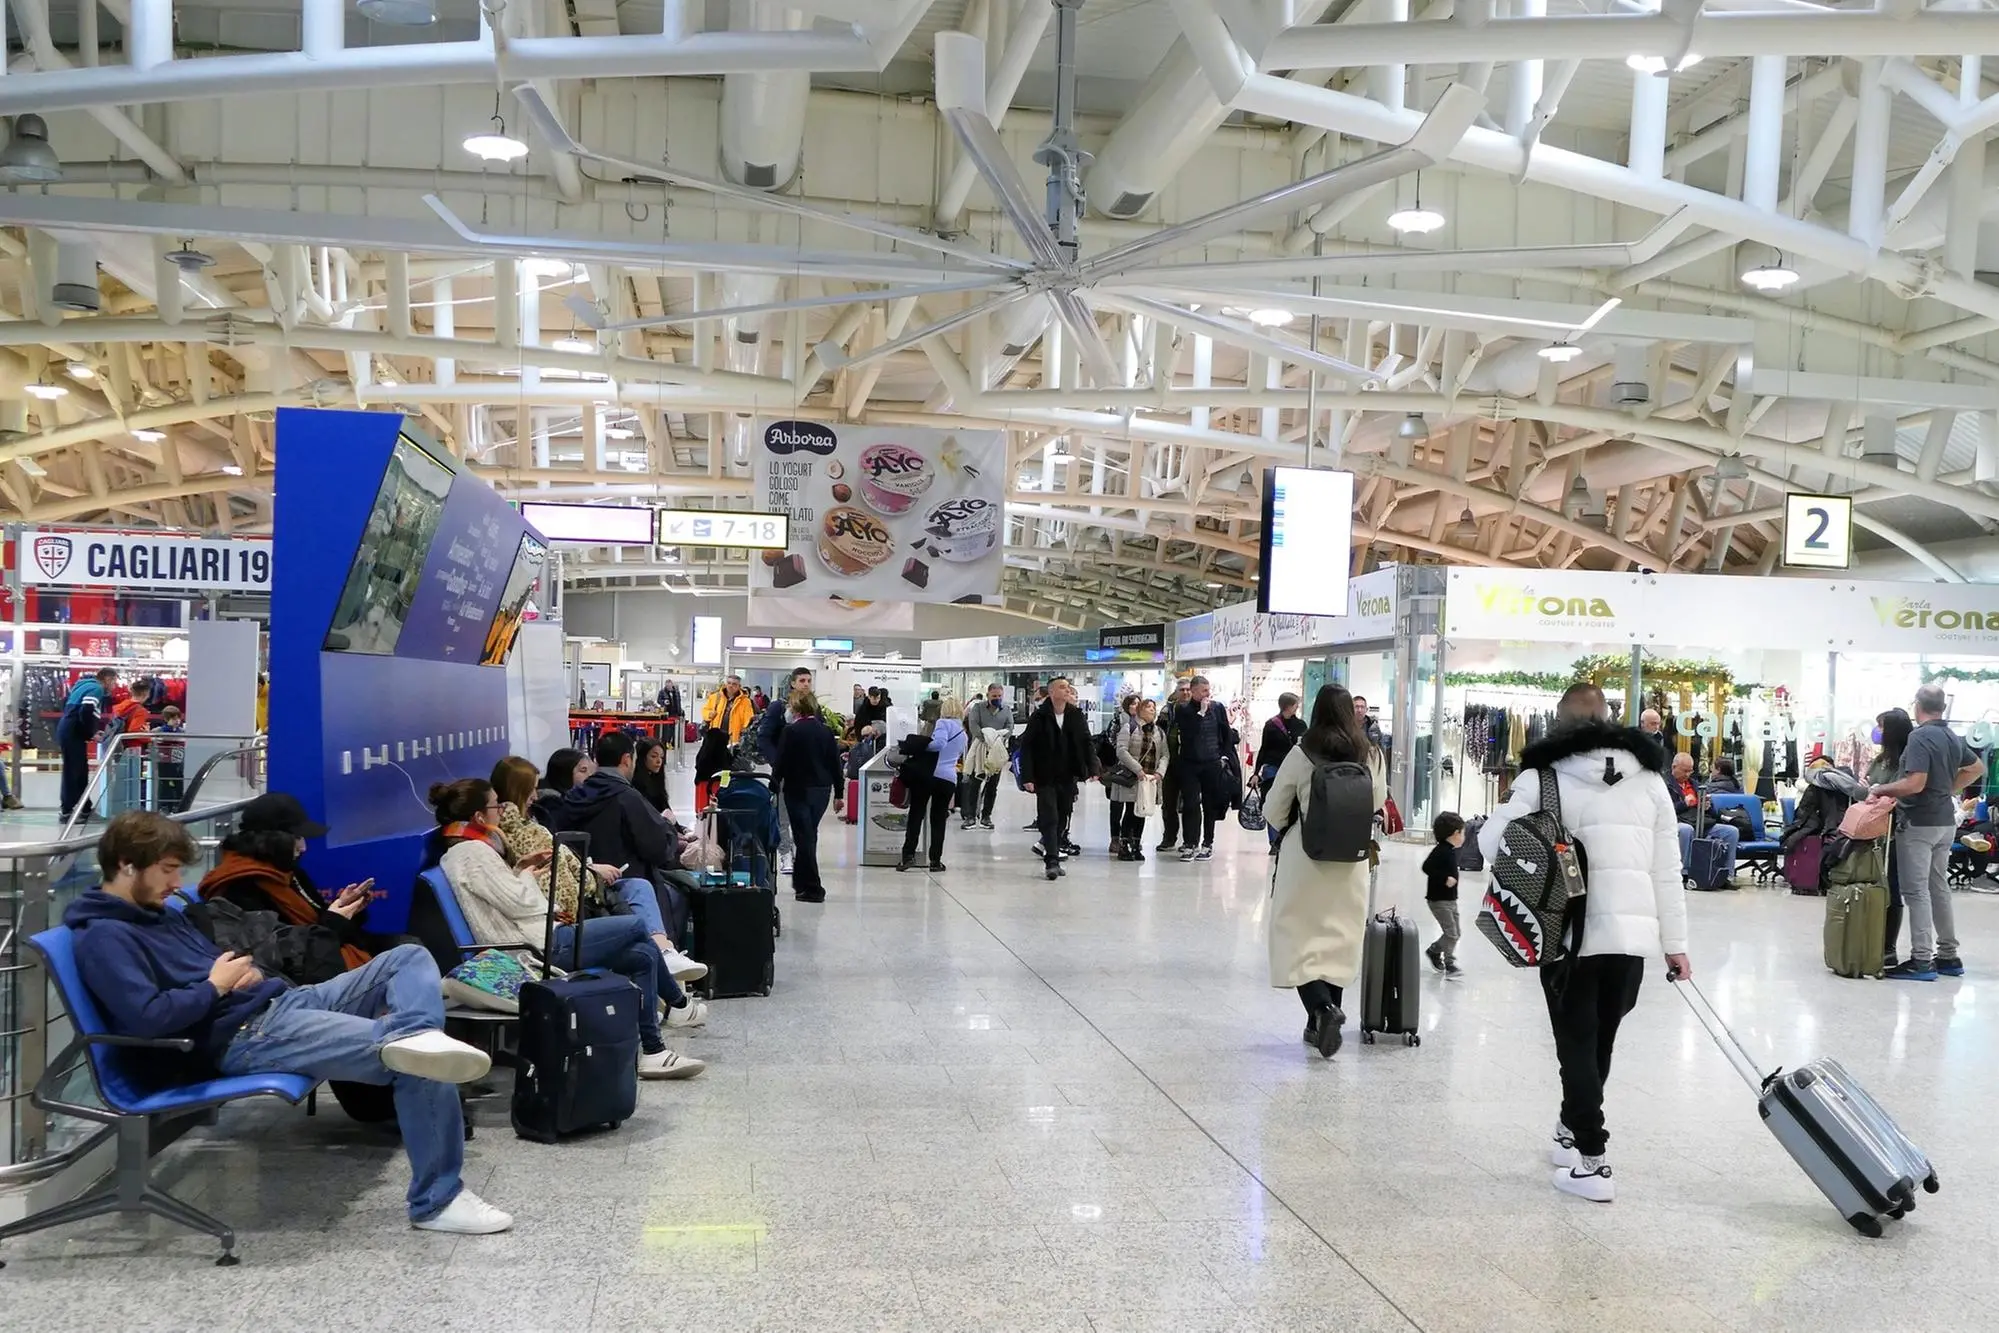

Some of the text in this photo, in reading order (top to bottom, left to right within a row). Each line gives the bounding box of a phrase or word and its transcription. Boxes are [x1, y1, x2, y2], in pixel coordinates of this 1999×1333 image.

[769, 428, 834, 447] Arborea
[769, 461, 813, 477] LO YOGURT
[768, 476, 799, 491] GOLOSO
[768, 491, 790, 506] COME
[722, 520, 777, 541] 7-18
[1804, 507, 1829, 549] 2
[87, 543, 230, 582] CAGLIARI
[1356, 591, 1391, 617] Verona
[1475, 583, 1615, 618] Verona
[1870, 596, 1999, 632] Verona
